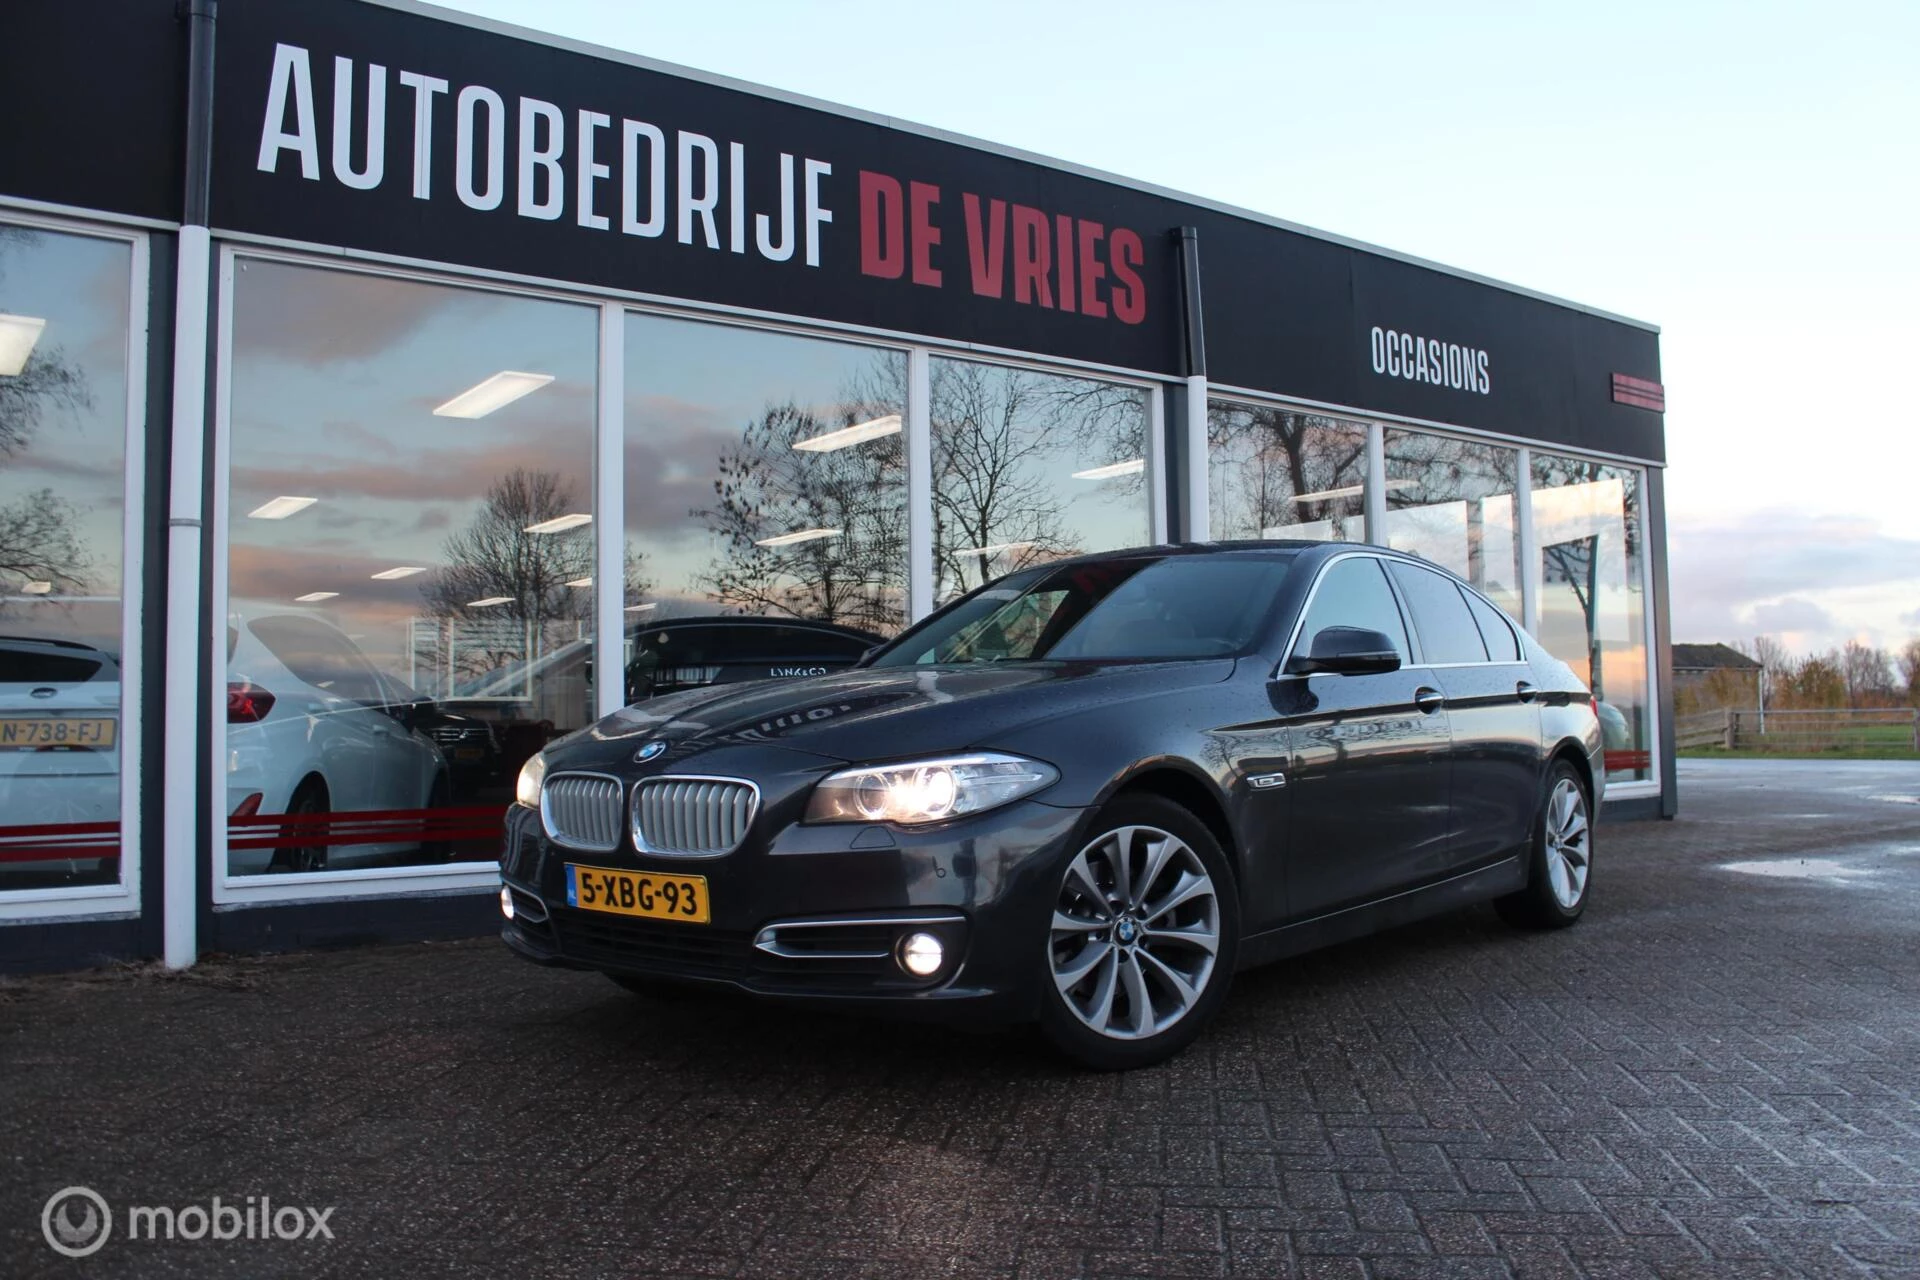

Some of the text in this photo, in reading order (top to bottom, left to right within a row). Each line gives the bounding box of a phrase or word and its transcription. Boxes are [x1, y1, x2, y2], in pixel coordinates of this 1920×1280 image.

[257, 42, 1146, 325] AUTOBEDRIJF DE VRIES
[1371, 326, 1490, 395] OCCASIONS
[581, 872, 697, 916] 5-XBG-93
